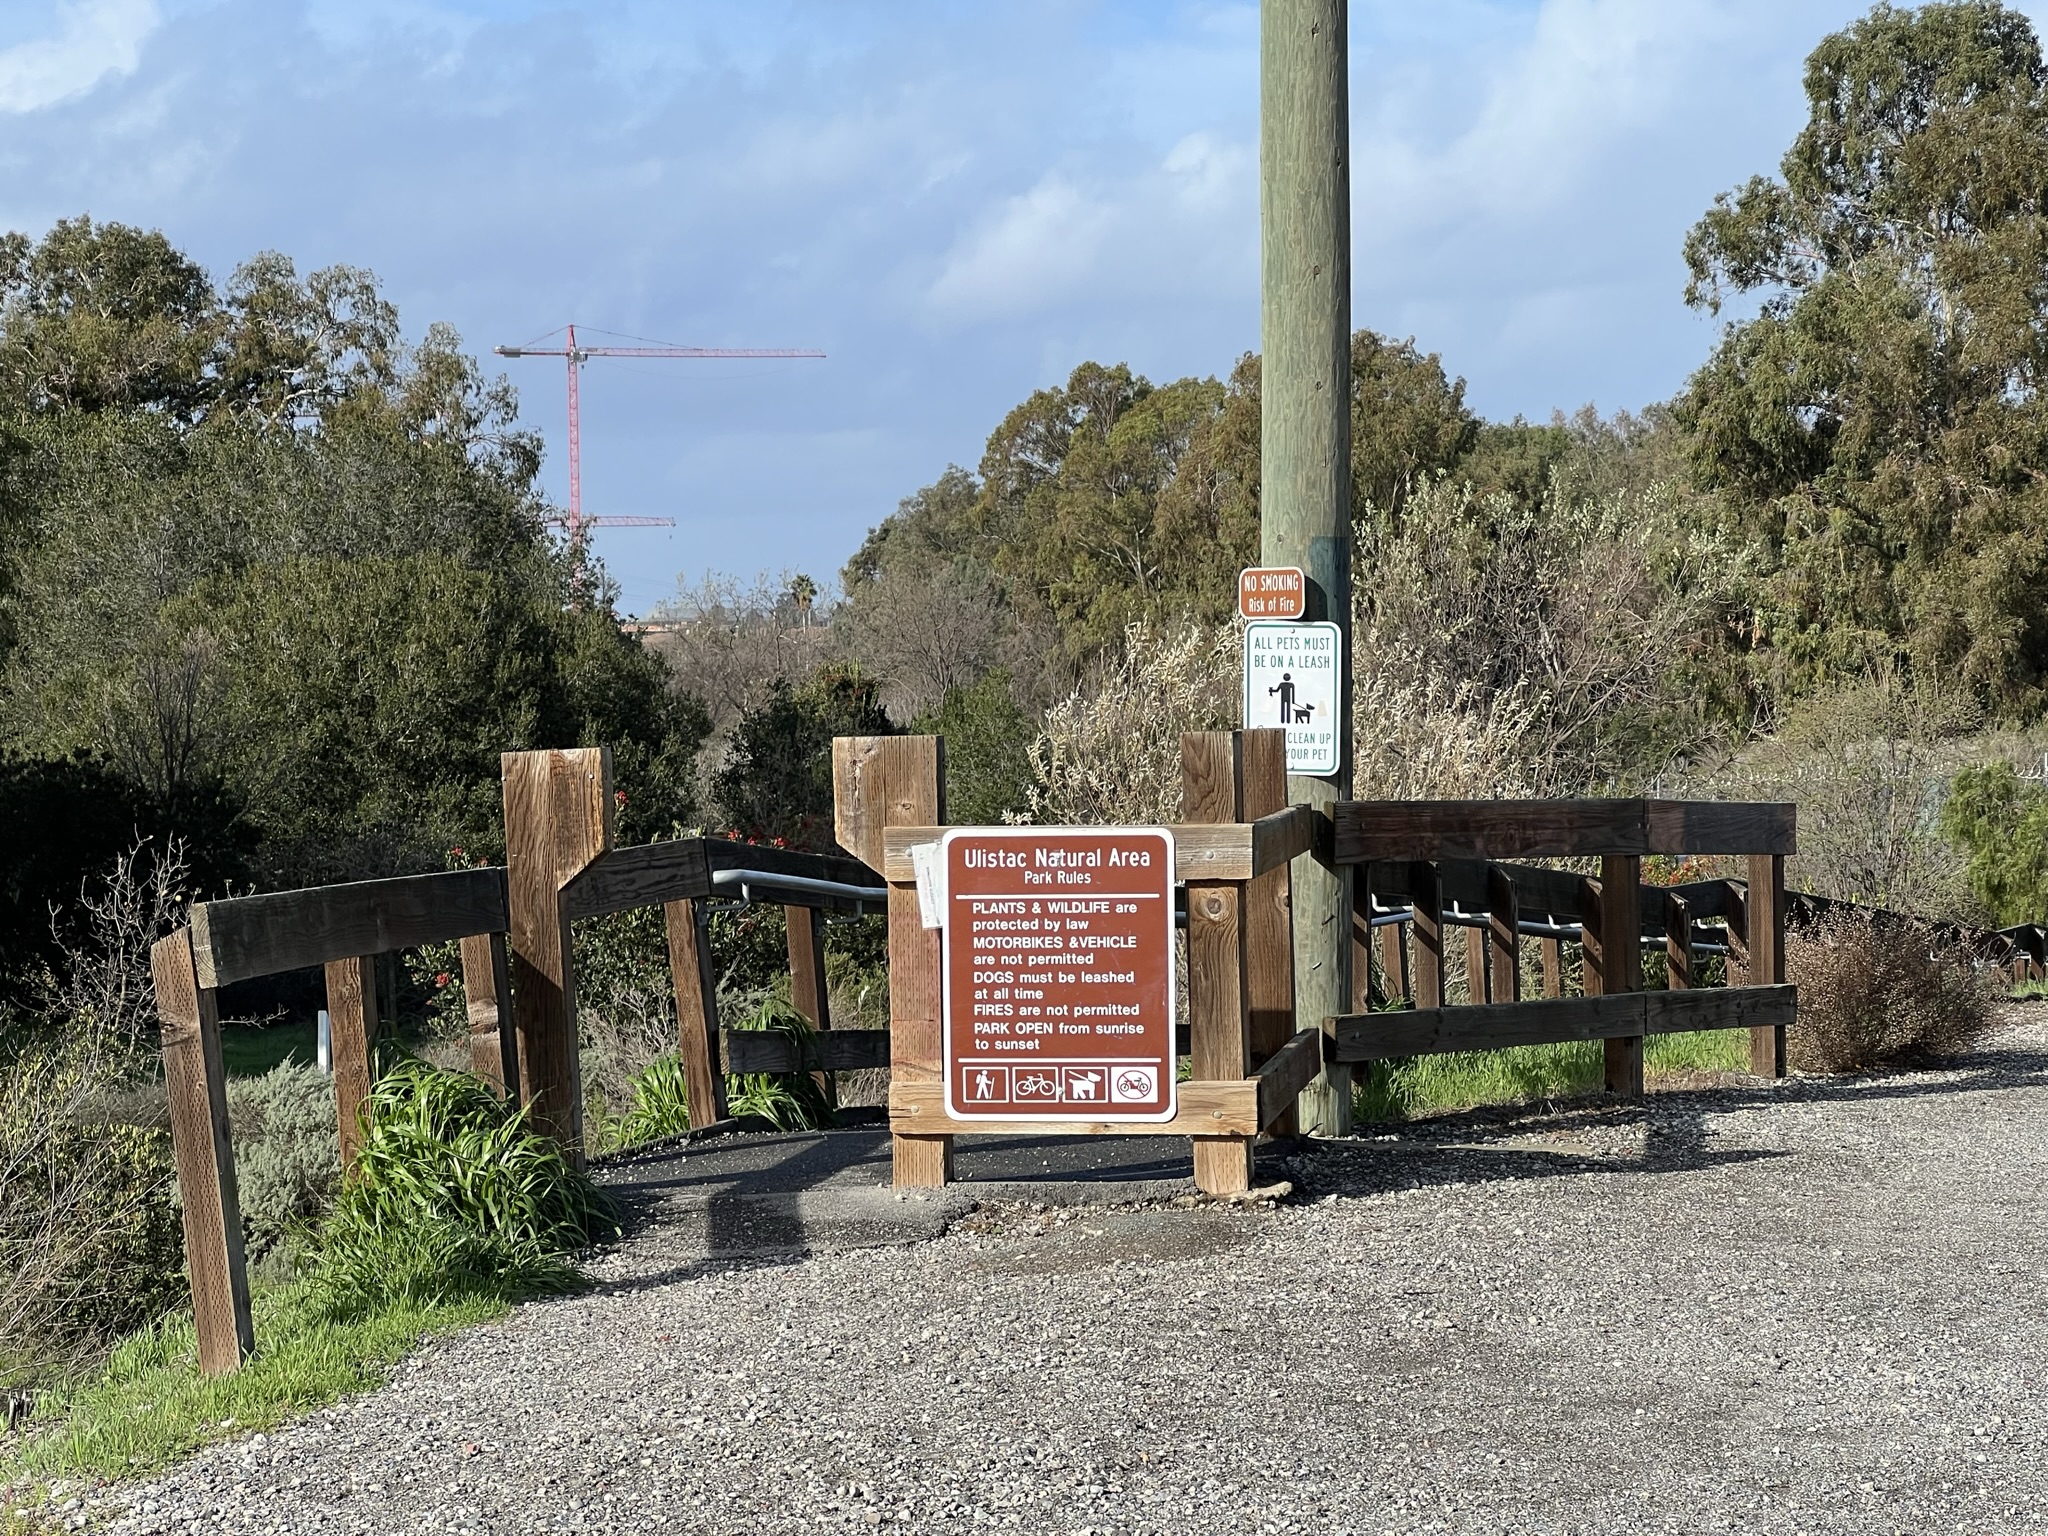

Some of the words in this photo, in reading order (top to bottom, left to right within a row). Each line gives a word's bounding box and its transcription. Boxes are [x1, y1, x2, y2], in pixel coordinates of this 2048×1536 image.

[1244, 575, 1257, 592] NO
[1260, 574, 1299, 591] SMOKING
[1248, 598, 1265, 613] Risk
[1268, 597, 1277, 612] of
[1279, 596, 1295, 612] Fire
[1254, 637, 1273, 650] ALL
[1277, 637, 1300, 650] PETS
[1304, 637, 1330, 651] MUST
[1254, 655, 1266, 668] BE
[1271, 655, 1284, 668] ON
[1288, 655, 1295, 668] A
[1298, 655, 1330, 669] LEASH
[1287, 732, 1316, 745] CLEAN
[1319, 732, 1332, 745] UP
[1312, 748, 1327, 761] PET
[964, 848, 1027, 868] Ulistac
[1035, 848, 1101, 868] Natural
[1109, 847, 1151, 867] Area
[1024, 870, 1052, 885] Park
[1057, 870, 1091, 884] Rules
[972, 902, 1026, 915] PLANTS
[1032, 902, 1042, 914] &
[1047, 902, 1110, 914] WILDLIFE
[1115, 904, 1138, 914] are
[972, 918, 1039, 933] protected
[1044, 918, 1060, 932] by
[1066, 918, 1089, 930] law
[973, 936, 1063, 949] MOTORBIKES
[973, 954, 995, 966] are
[1000, 953, 1023, 965] not
[1028, 952, 1094, 967] permitted
[973, 972, 1014, 984] DOGS
[1019, 972, 1053, 984] must
[1058, 971, 1076, 983] be
[1081, 971, 1135, 983] leashed
[974, 989, 988, 1000] at
[993, 988, 1009, 1000] all
[1014, 988, 1044, 1000] time
[973, 1004, 1013, 1017] FIRES
[1019, 1006, 1041, 1016] are
[1046, 1005, 1068, 1016] not
[1073, 1004, 1140, 1018] permitted
[974, 1023, 1010, 1035] PARK
[1015, 1022, 1053, 1034] OPEN
[1059, 1022, 1090, 1034] from
[1095, 1022, 1145, 1034] sunrise
[975, 1039, 989, 1050] to
[994, 1039, 1040, 1050] sunset
